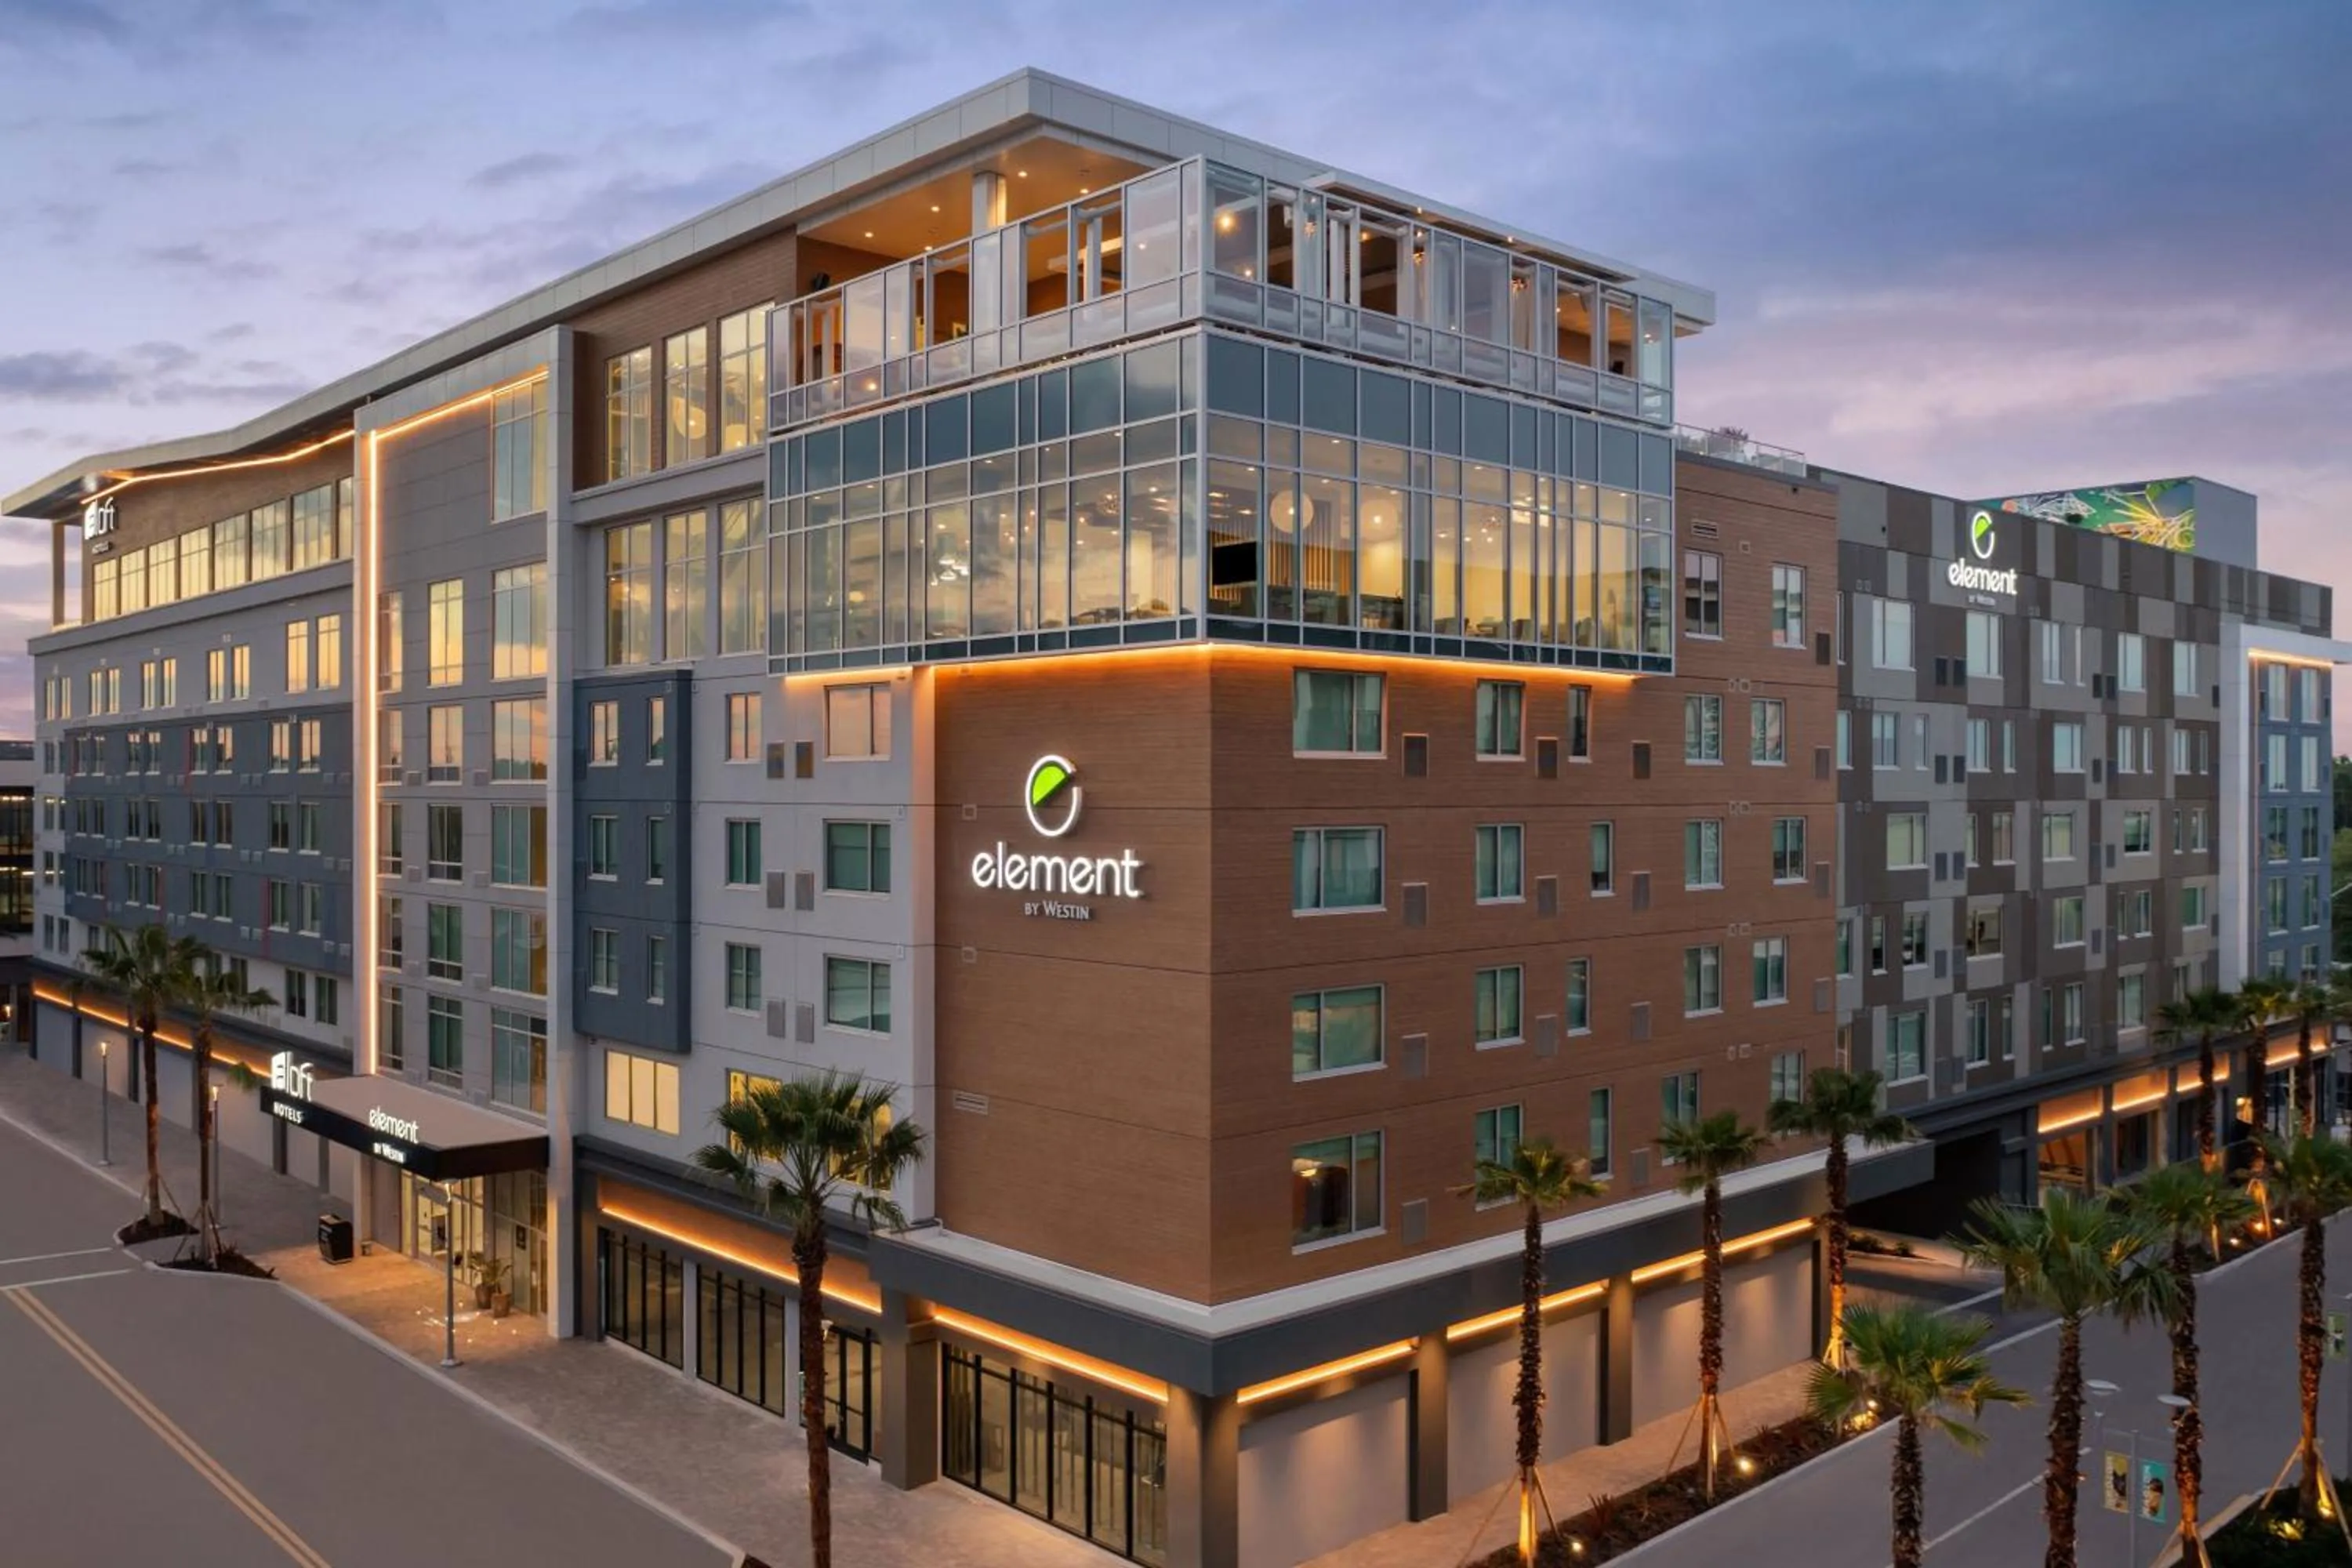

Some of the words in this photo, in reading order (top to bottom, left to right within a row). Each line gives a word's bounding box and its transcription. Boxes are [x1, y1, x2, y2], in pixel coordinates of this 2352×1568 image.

[1947, 557, 2018, 596] element
[971, 840, 1144, 898] element
[1024, 902, 1040, 916] BY
[274, 1101, 303, 1123] HOTELS
[368, 1105, 419, 1144] element
